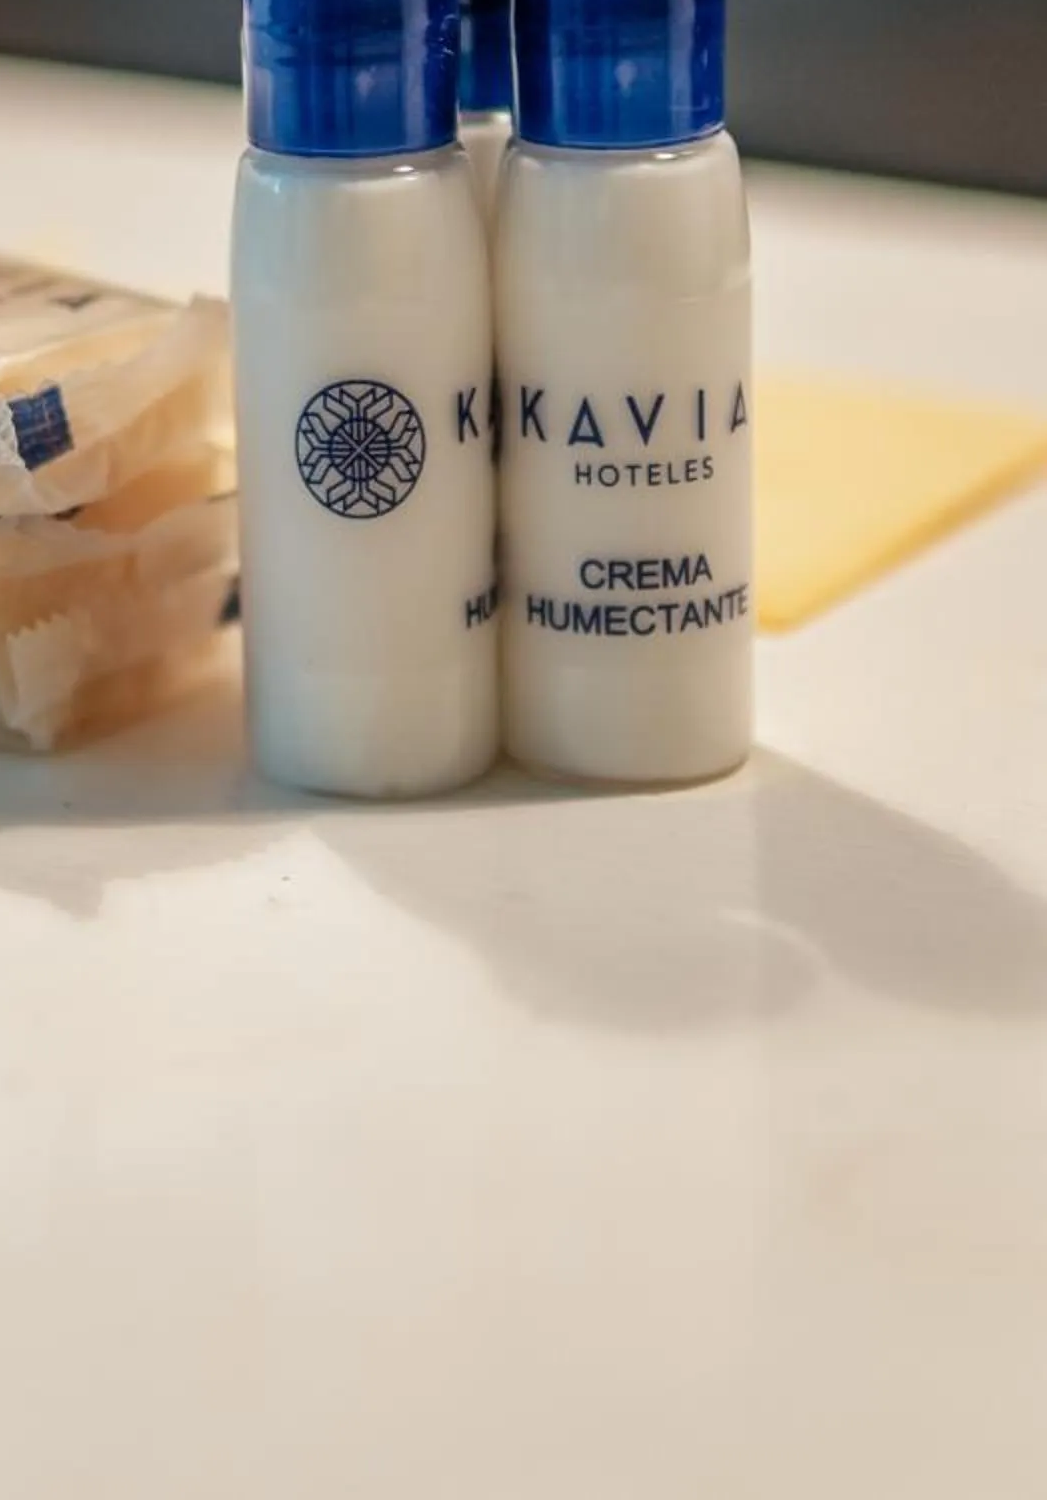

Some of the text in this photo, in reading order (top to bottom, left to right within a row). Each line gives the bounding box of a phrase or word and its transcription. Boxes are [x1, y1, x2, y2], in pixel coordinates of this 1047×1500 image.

[520, 381, 747, 447] KAVIA
[575, 456, 714, 487] HOTELES
[579, 554, 713, 591] CREMA
[526, 582, 749, 636] HUMECTANTE
